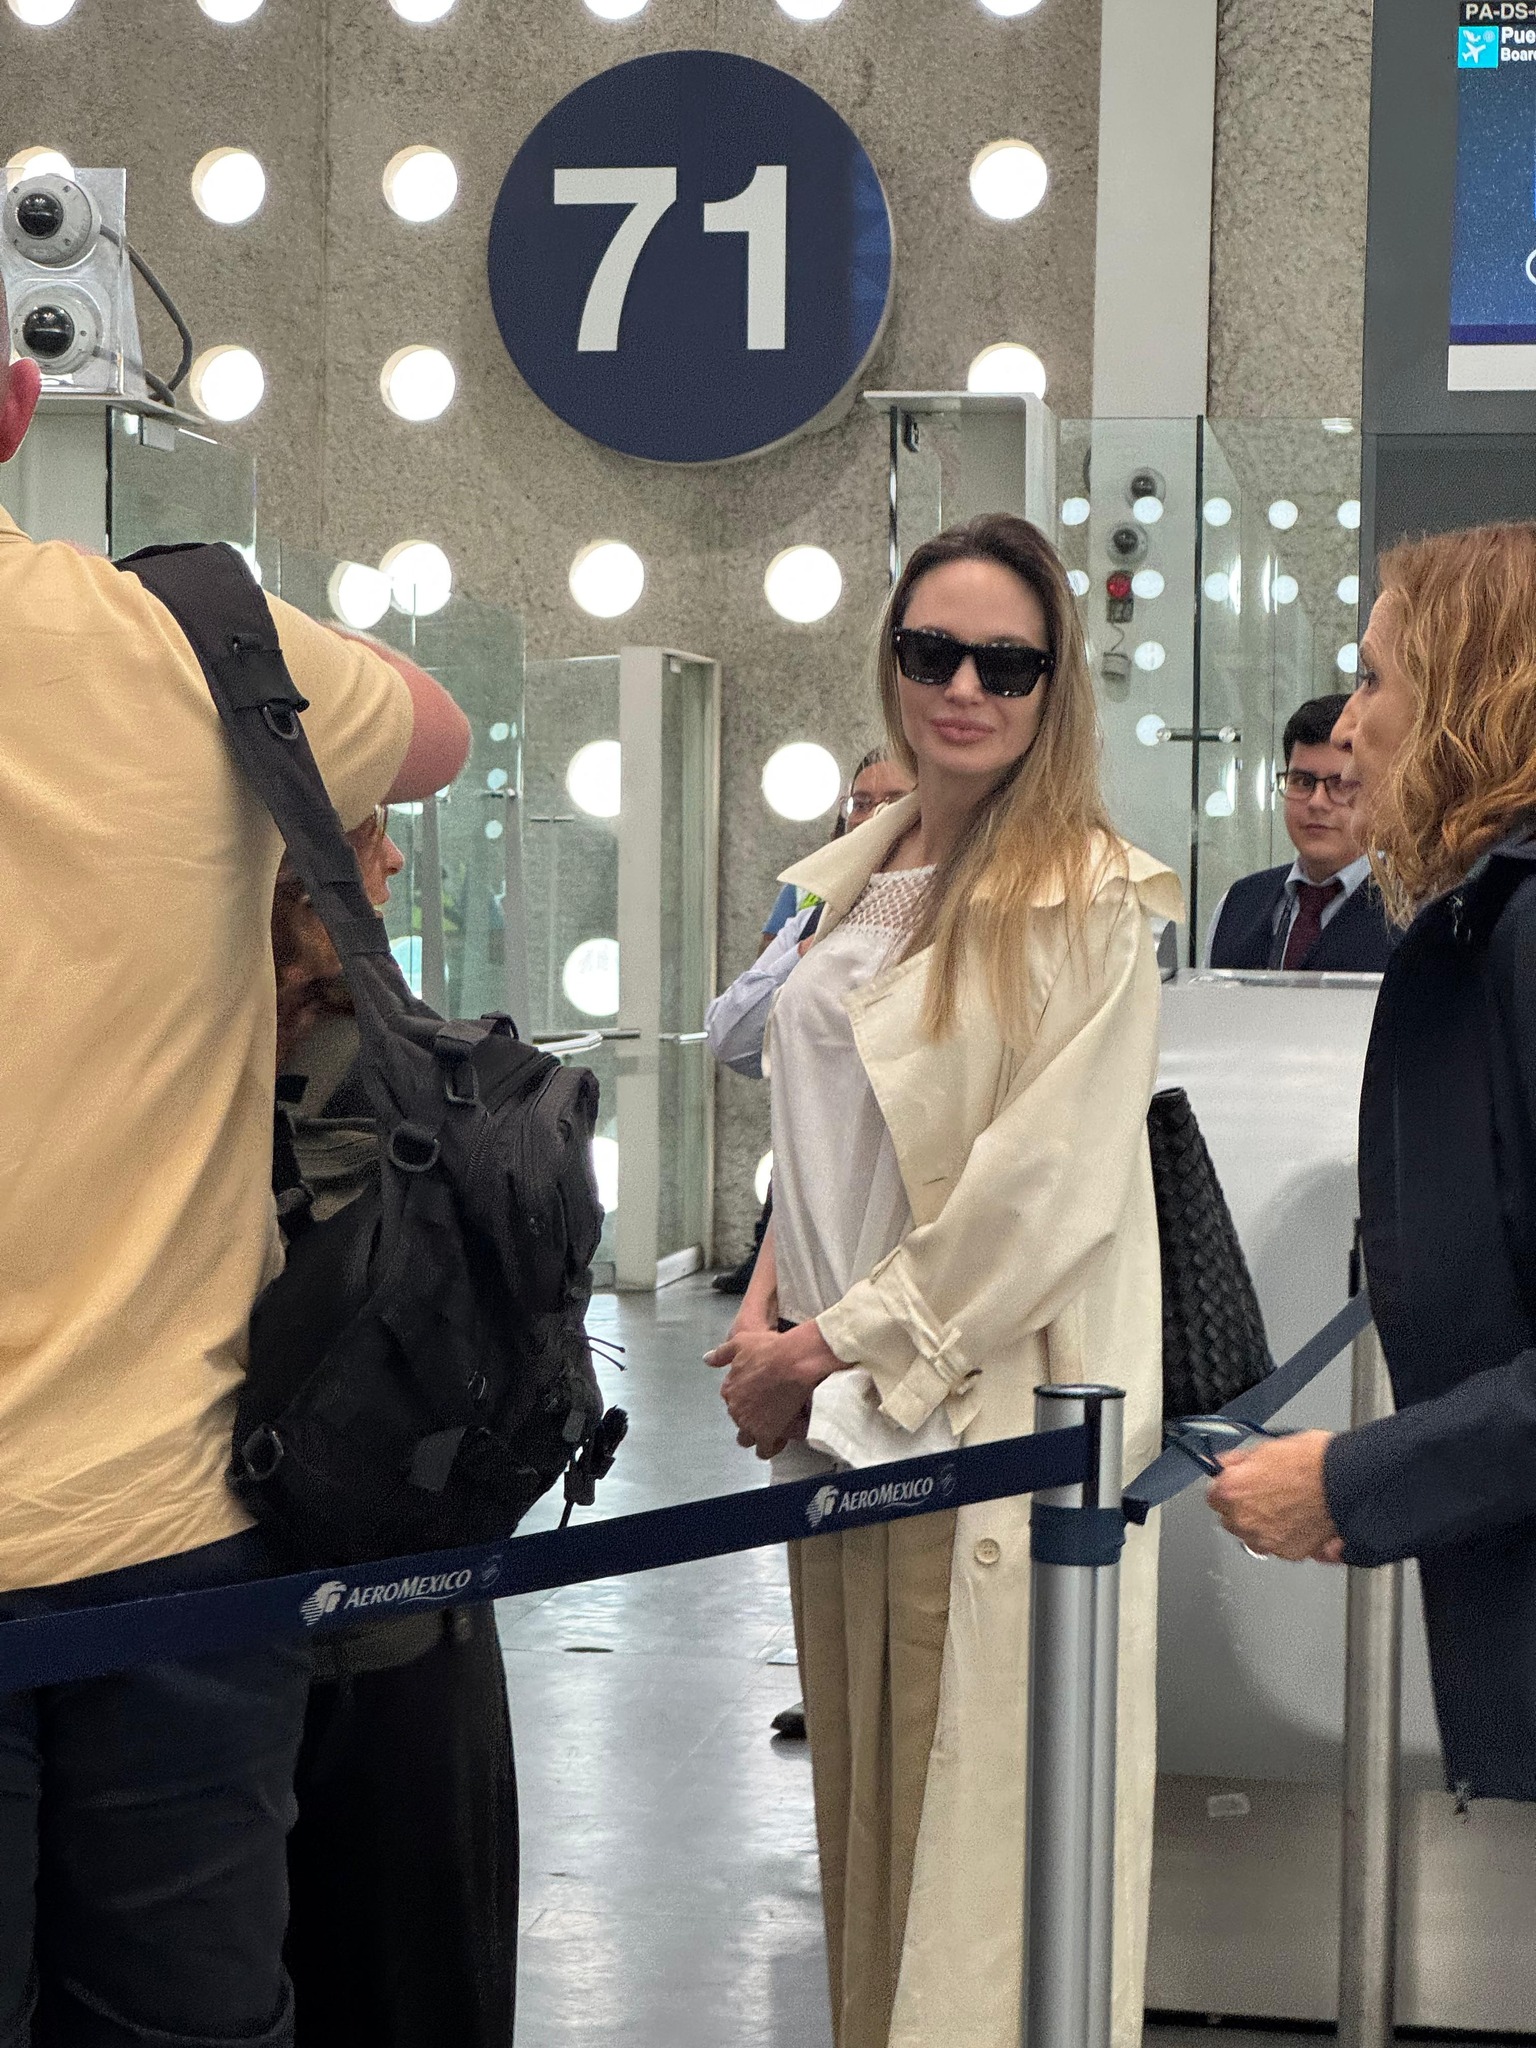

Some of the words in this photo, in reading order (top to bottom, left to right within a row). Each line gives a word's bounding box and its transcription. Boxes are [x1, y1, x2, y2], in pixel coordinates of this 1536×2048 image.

[1465, 2, 1536, 20] PA-DS-
[1500, 47, 1536, 61] Boar
[553, 165, 787, 352] 71
[837, 1476, 934, 1513] AEROMEXICO
[343, 1569, 472, 1609] AEROMEXICO
